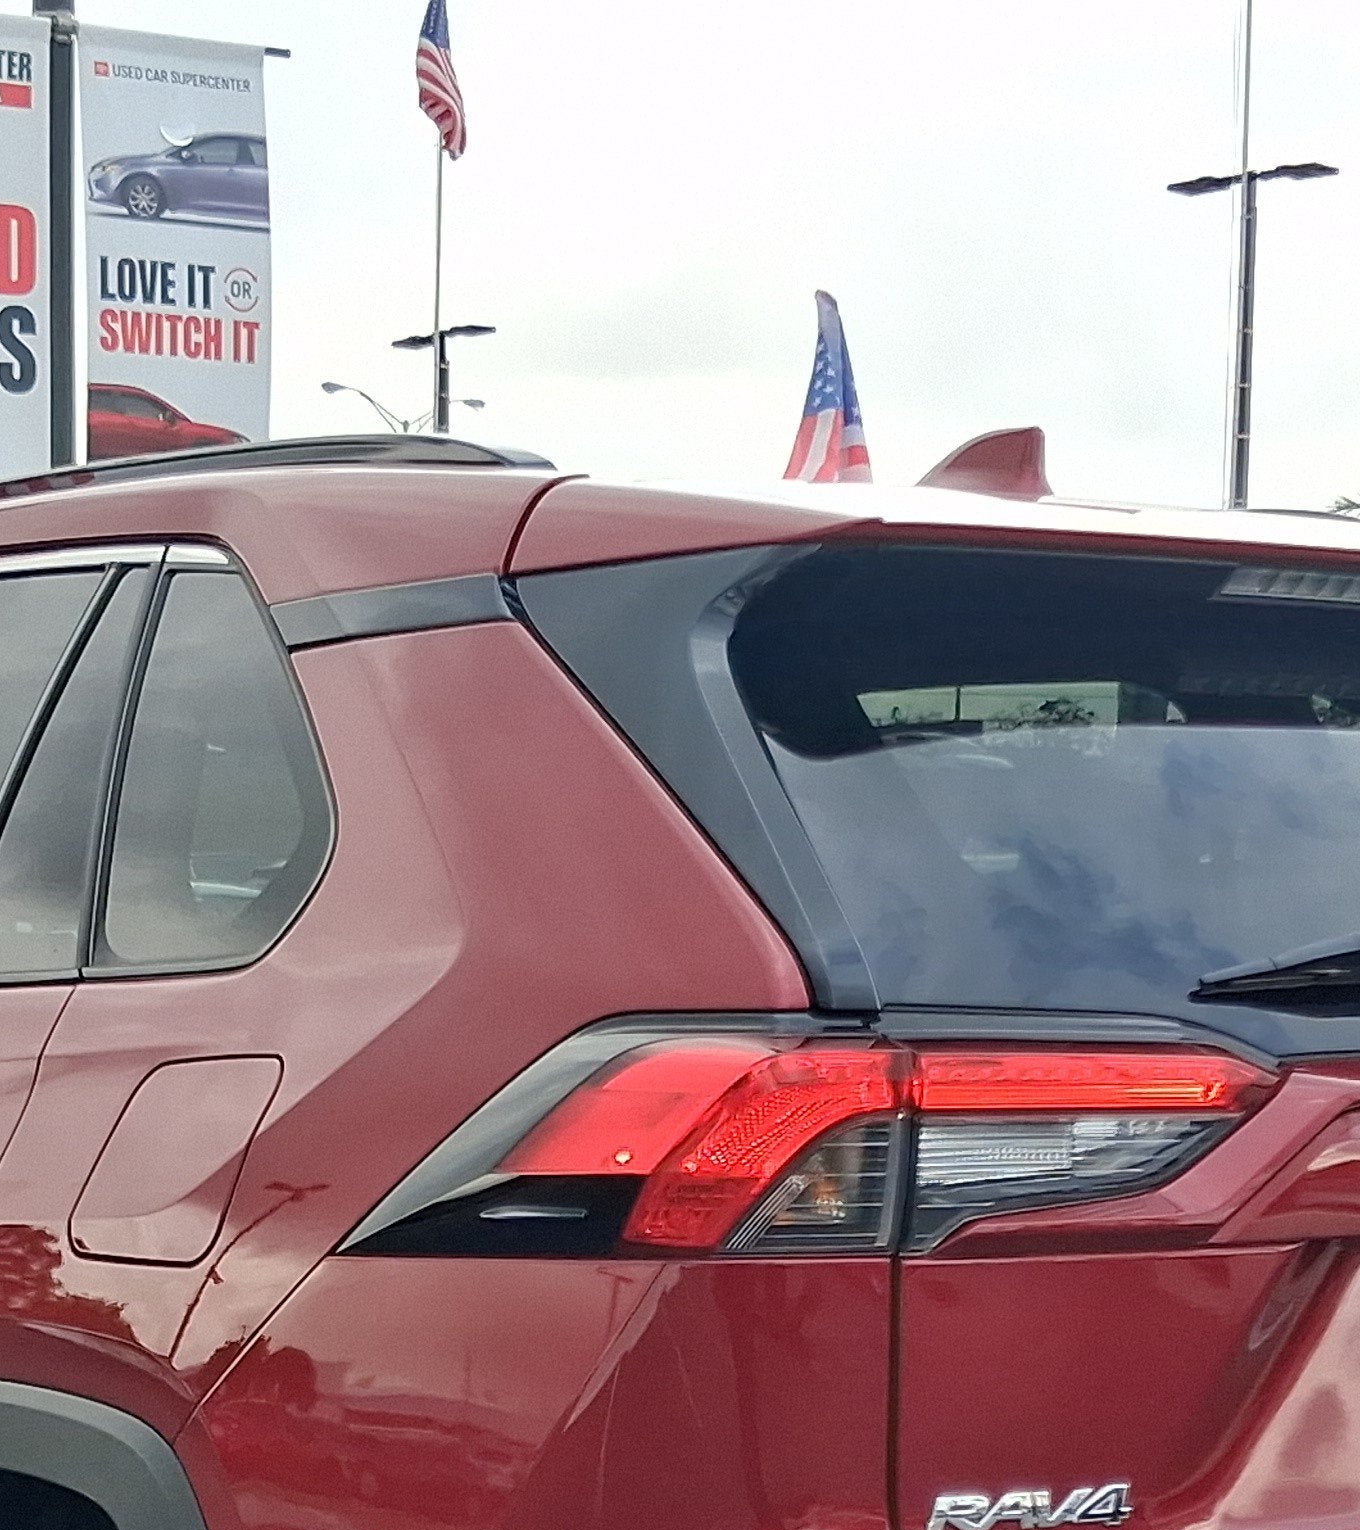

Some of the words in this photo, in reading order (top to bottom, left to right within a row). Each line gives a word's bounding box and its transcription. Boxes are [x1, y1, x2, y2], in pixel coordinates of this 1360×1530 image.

[112, 63, 143, 80] USED
[145, 68, 169, 84] CAR
[170, 70, 251, 92] SUPERCENTER
[100, 255, 177, 307] LOVE
[187, 264, 216, 310] IT
[230, 279, 252, 300] OR
[99, 308, 224, 362] SWITCH
[233, 319, 261, 365] IT
